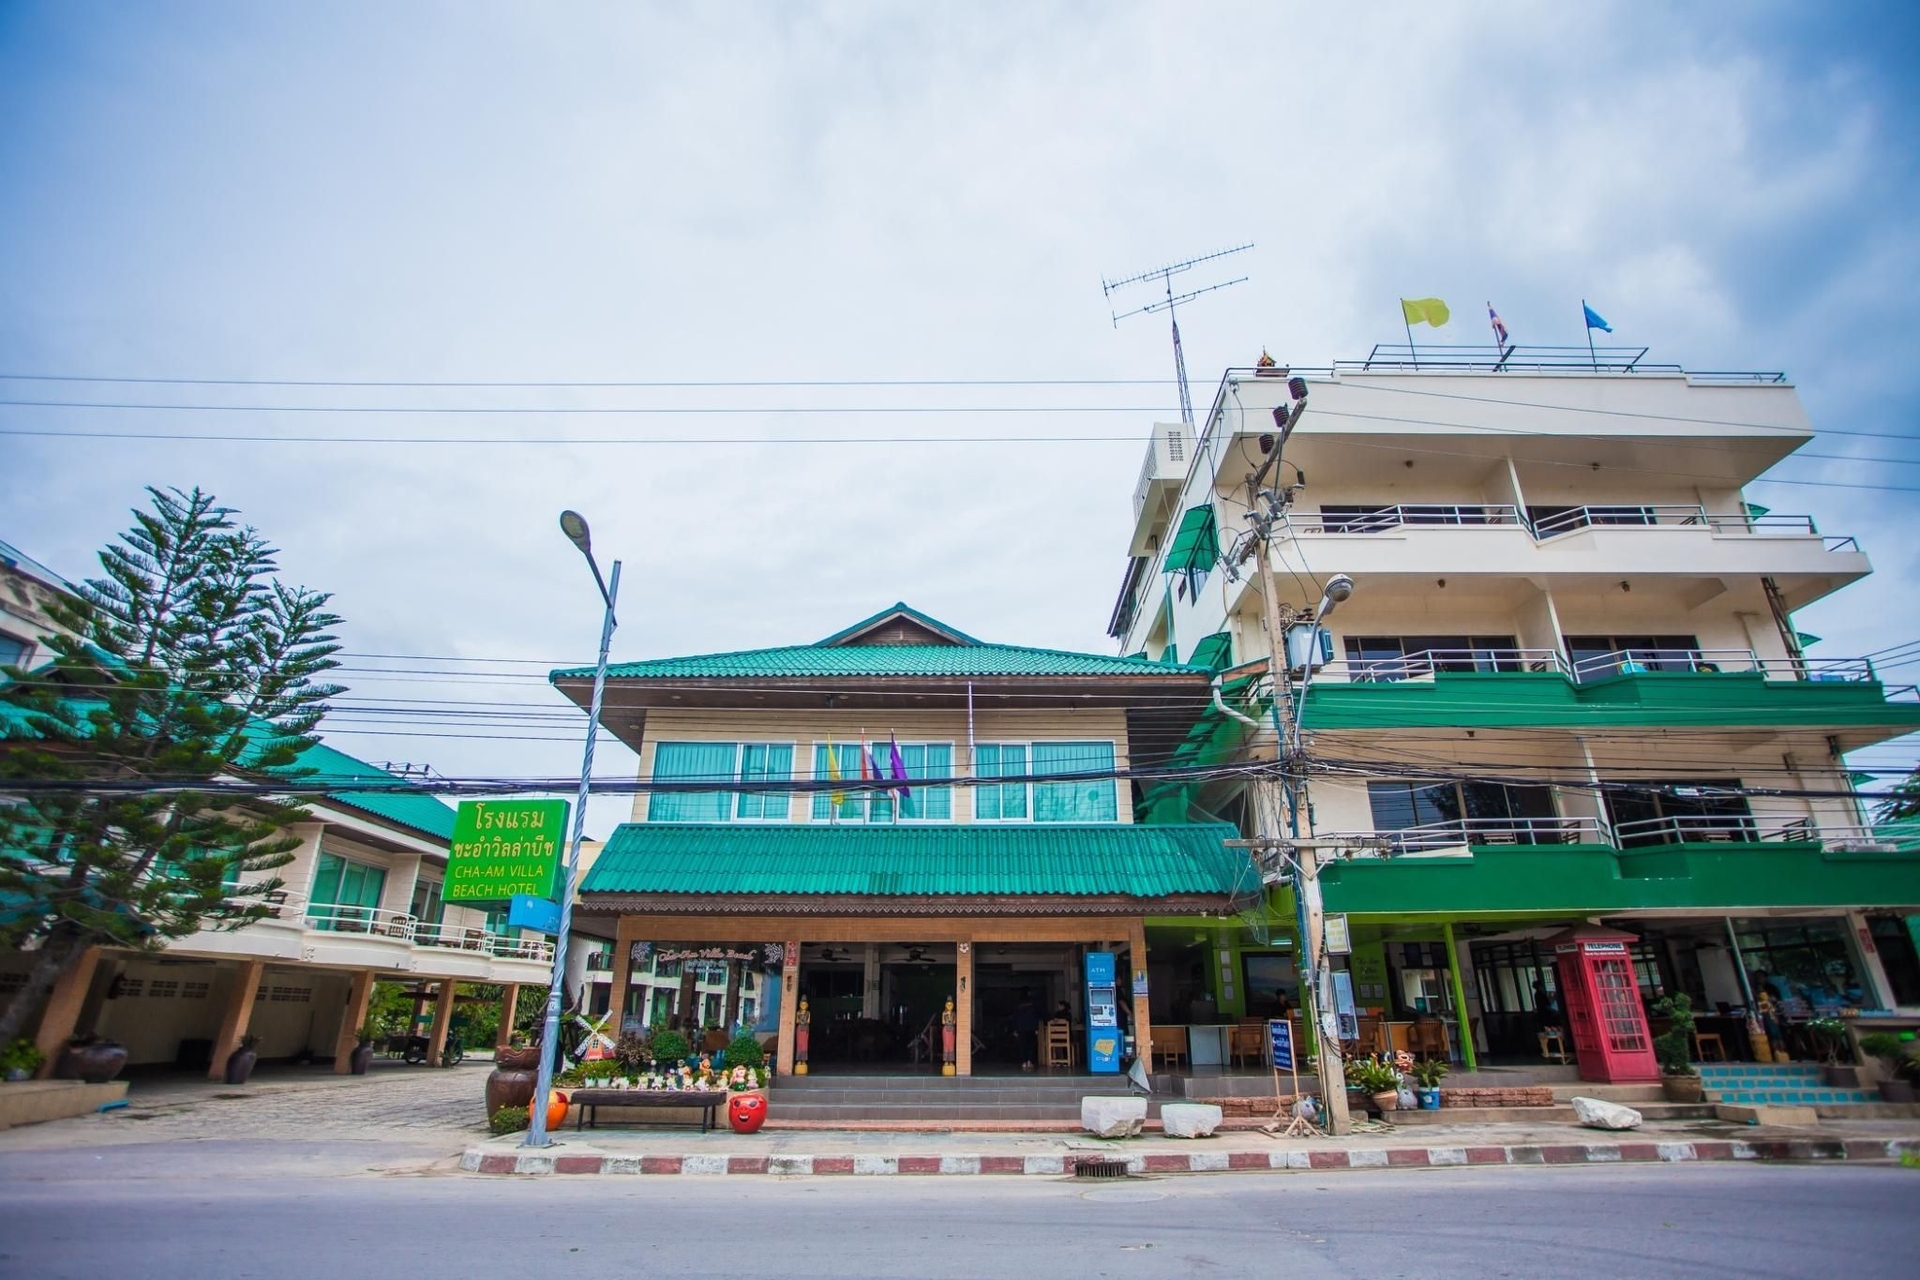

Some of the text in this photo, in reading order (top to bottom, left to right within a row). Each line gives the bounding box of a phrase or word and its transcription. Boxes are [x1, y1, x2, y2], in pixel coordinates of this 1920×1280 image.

[475, 803, 545, 829] โรงแรม
[454, 835, 554, 858] ชะอำวิลล่าบีช
[455, 865, 543, 878] CHA-AM VILLA
[453, 883, 539, 897] BEACH HOTEL
